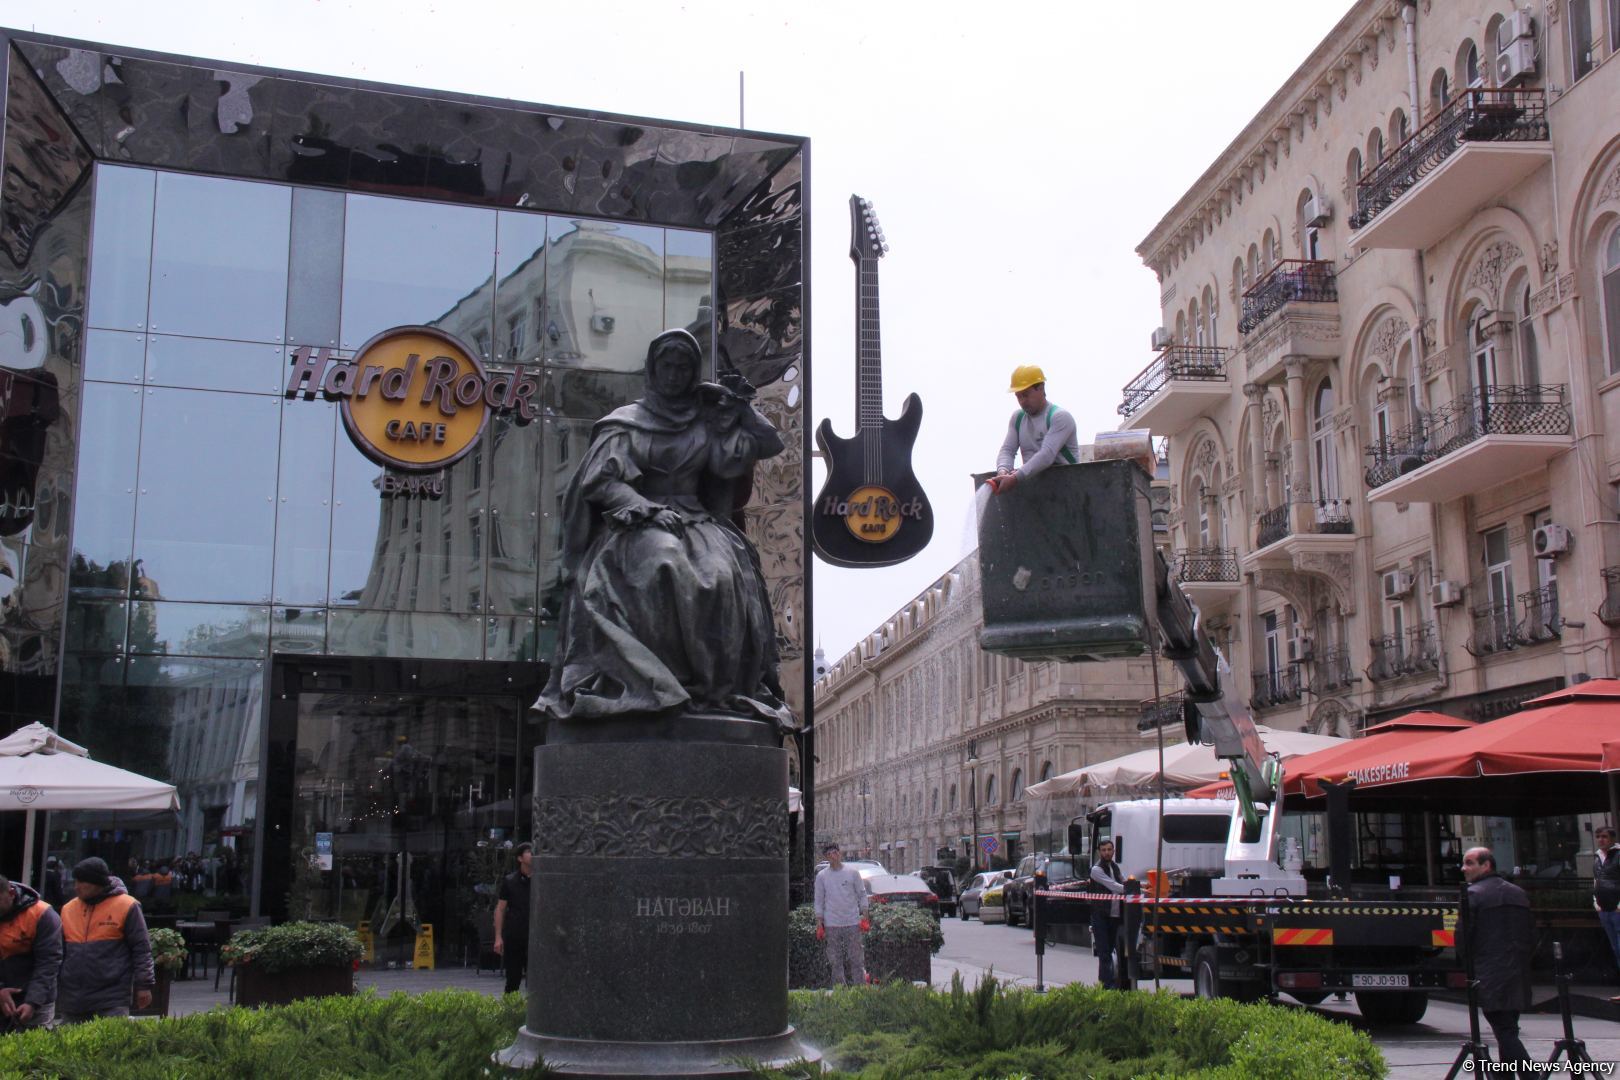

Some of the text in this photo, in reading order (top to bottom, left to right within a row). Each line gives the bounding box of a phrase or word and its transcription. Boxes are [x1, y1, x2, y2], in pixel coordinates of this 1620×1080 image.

[284, 345, 538, 426] Hard Rock
[385, 419, 447, 443] CAFE
[381, 474, 446, 497] BAKU
[823, 495, 923, 520] Hard Rock
